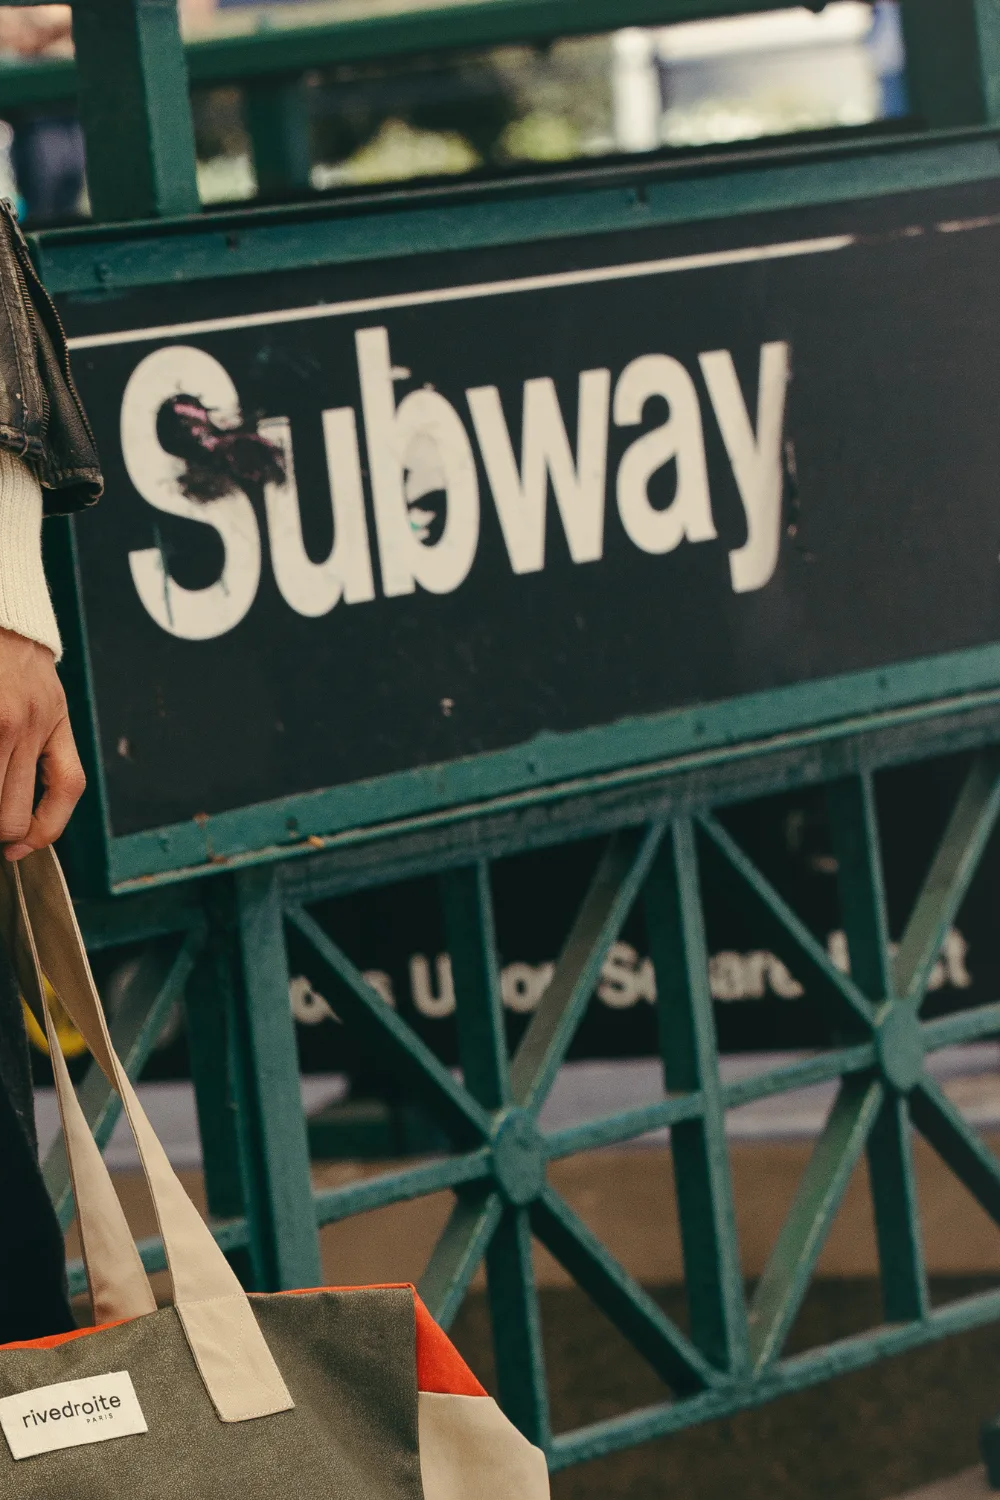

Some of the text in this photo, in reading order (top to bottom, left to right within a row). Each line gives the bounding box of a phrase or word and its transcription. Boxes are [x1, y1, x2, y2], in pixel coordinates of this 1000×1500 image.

[120, 326, 791, 641] Subway
[22, 1394, 122, 1429] rivedroite
[86, 1412, 114, 1425] PARIS
